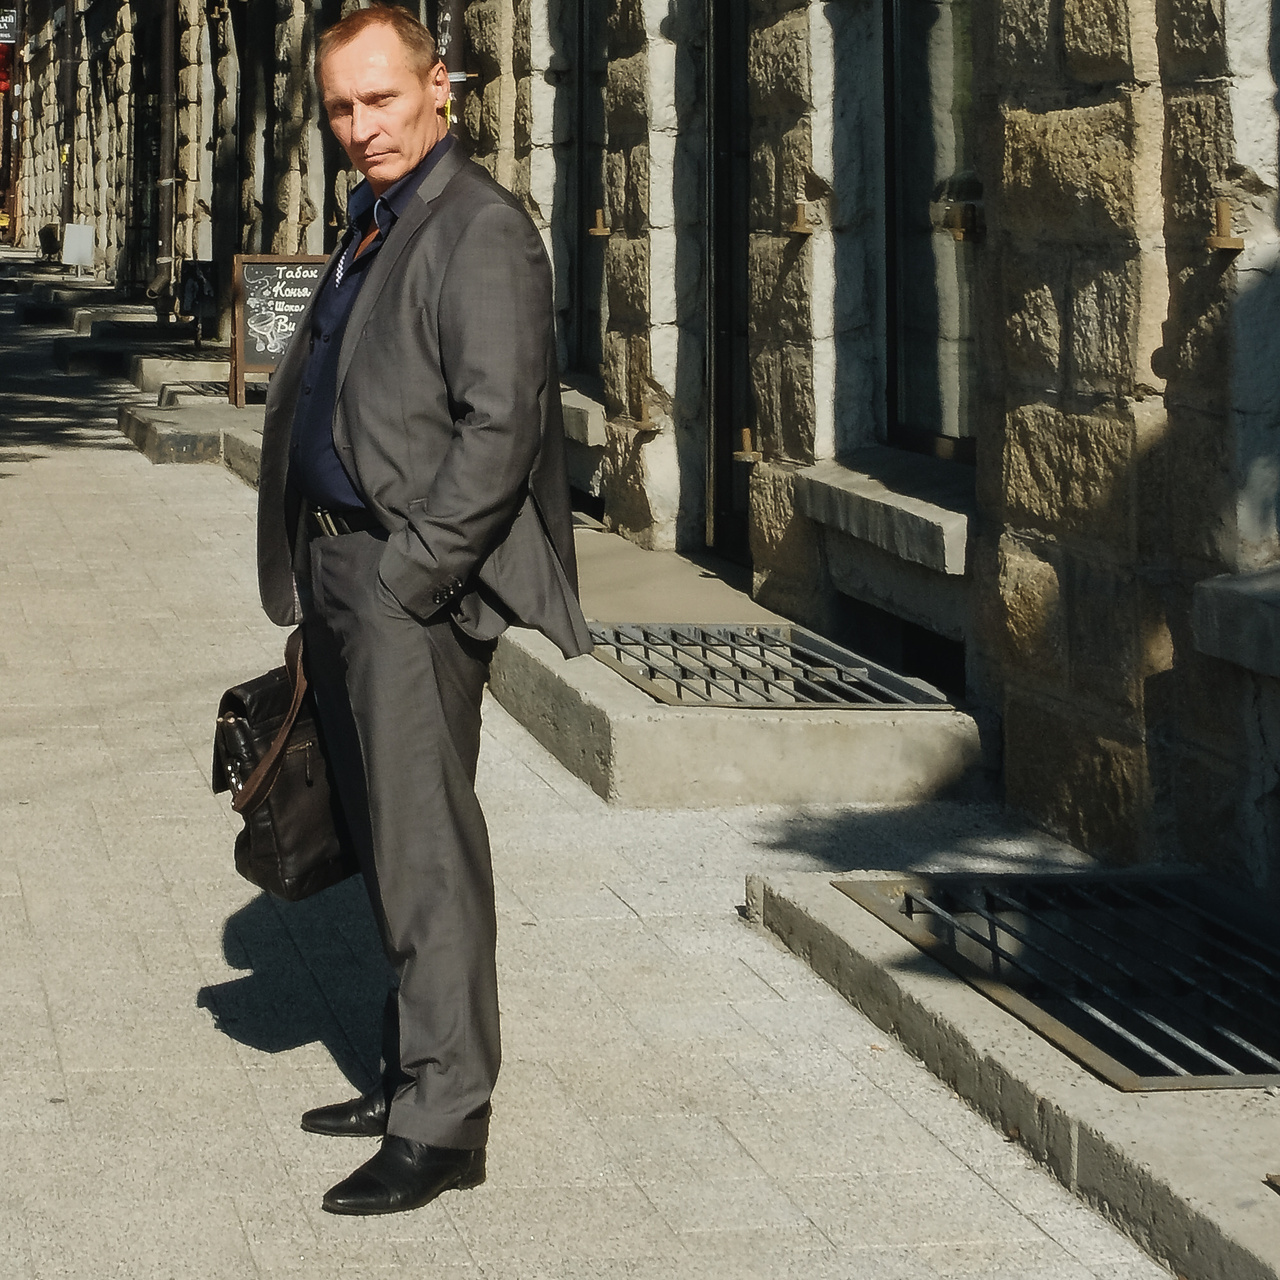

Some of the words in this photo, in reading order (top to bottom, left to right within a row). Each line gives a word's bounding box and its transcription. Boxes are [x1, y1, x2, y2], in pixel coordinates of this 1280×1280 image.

[275, 266, 318, 279] Табак
[272, 280, 312, 297] Конья
[275, 314, 296, 333] Ви
